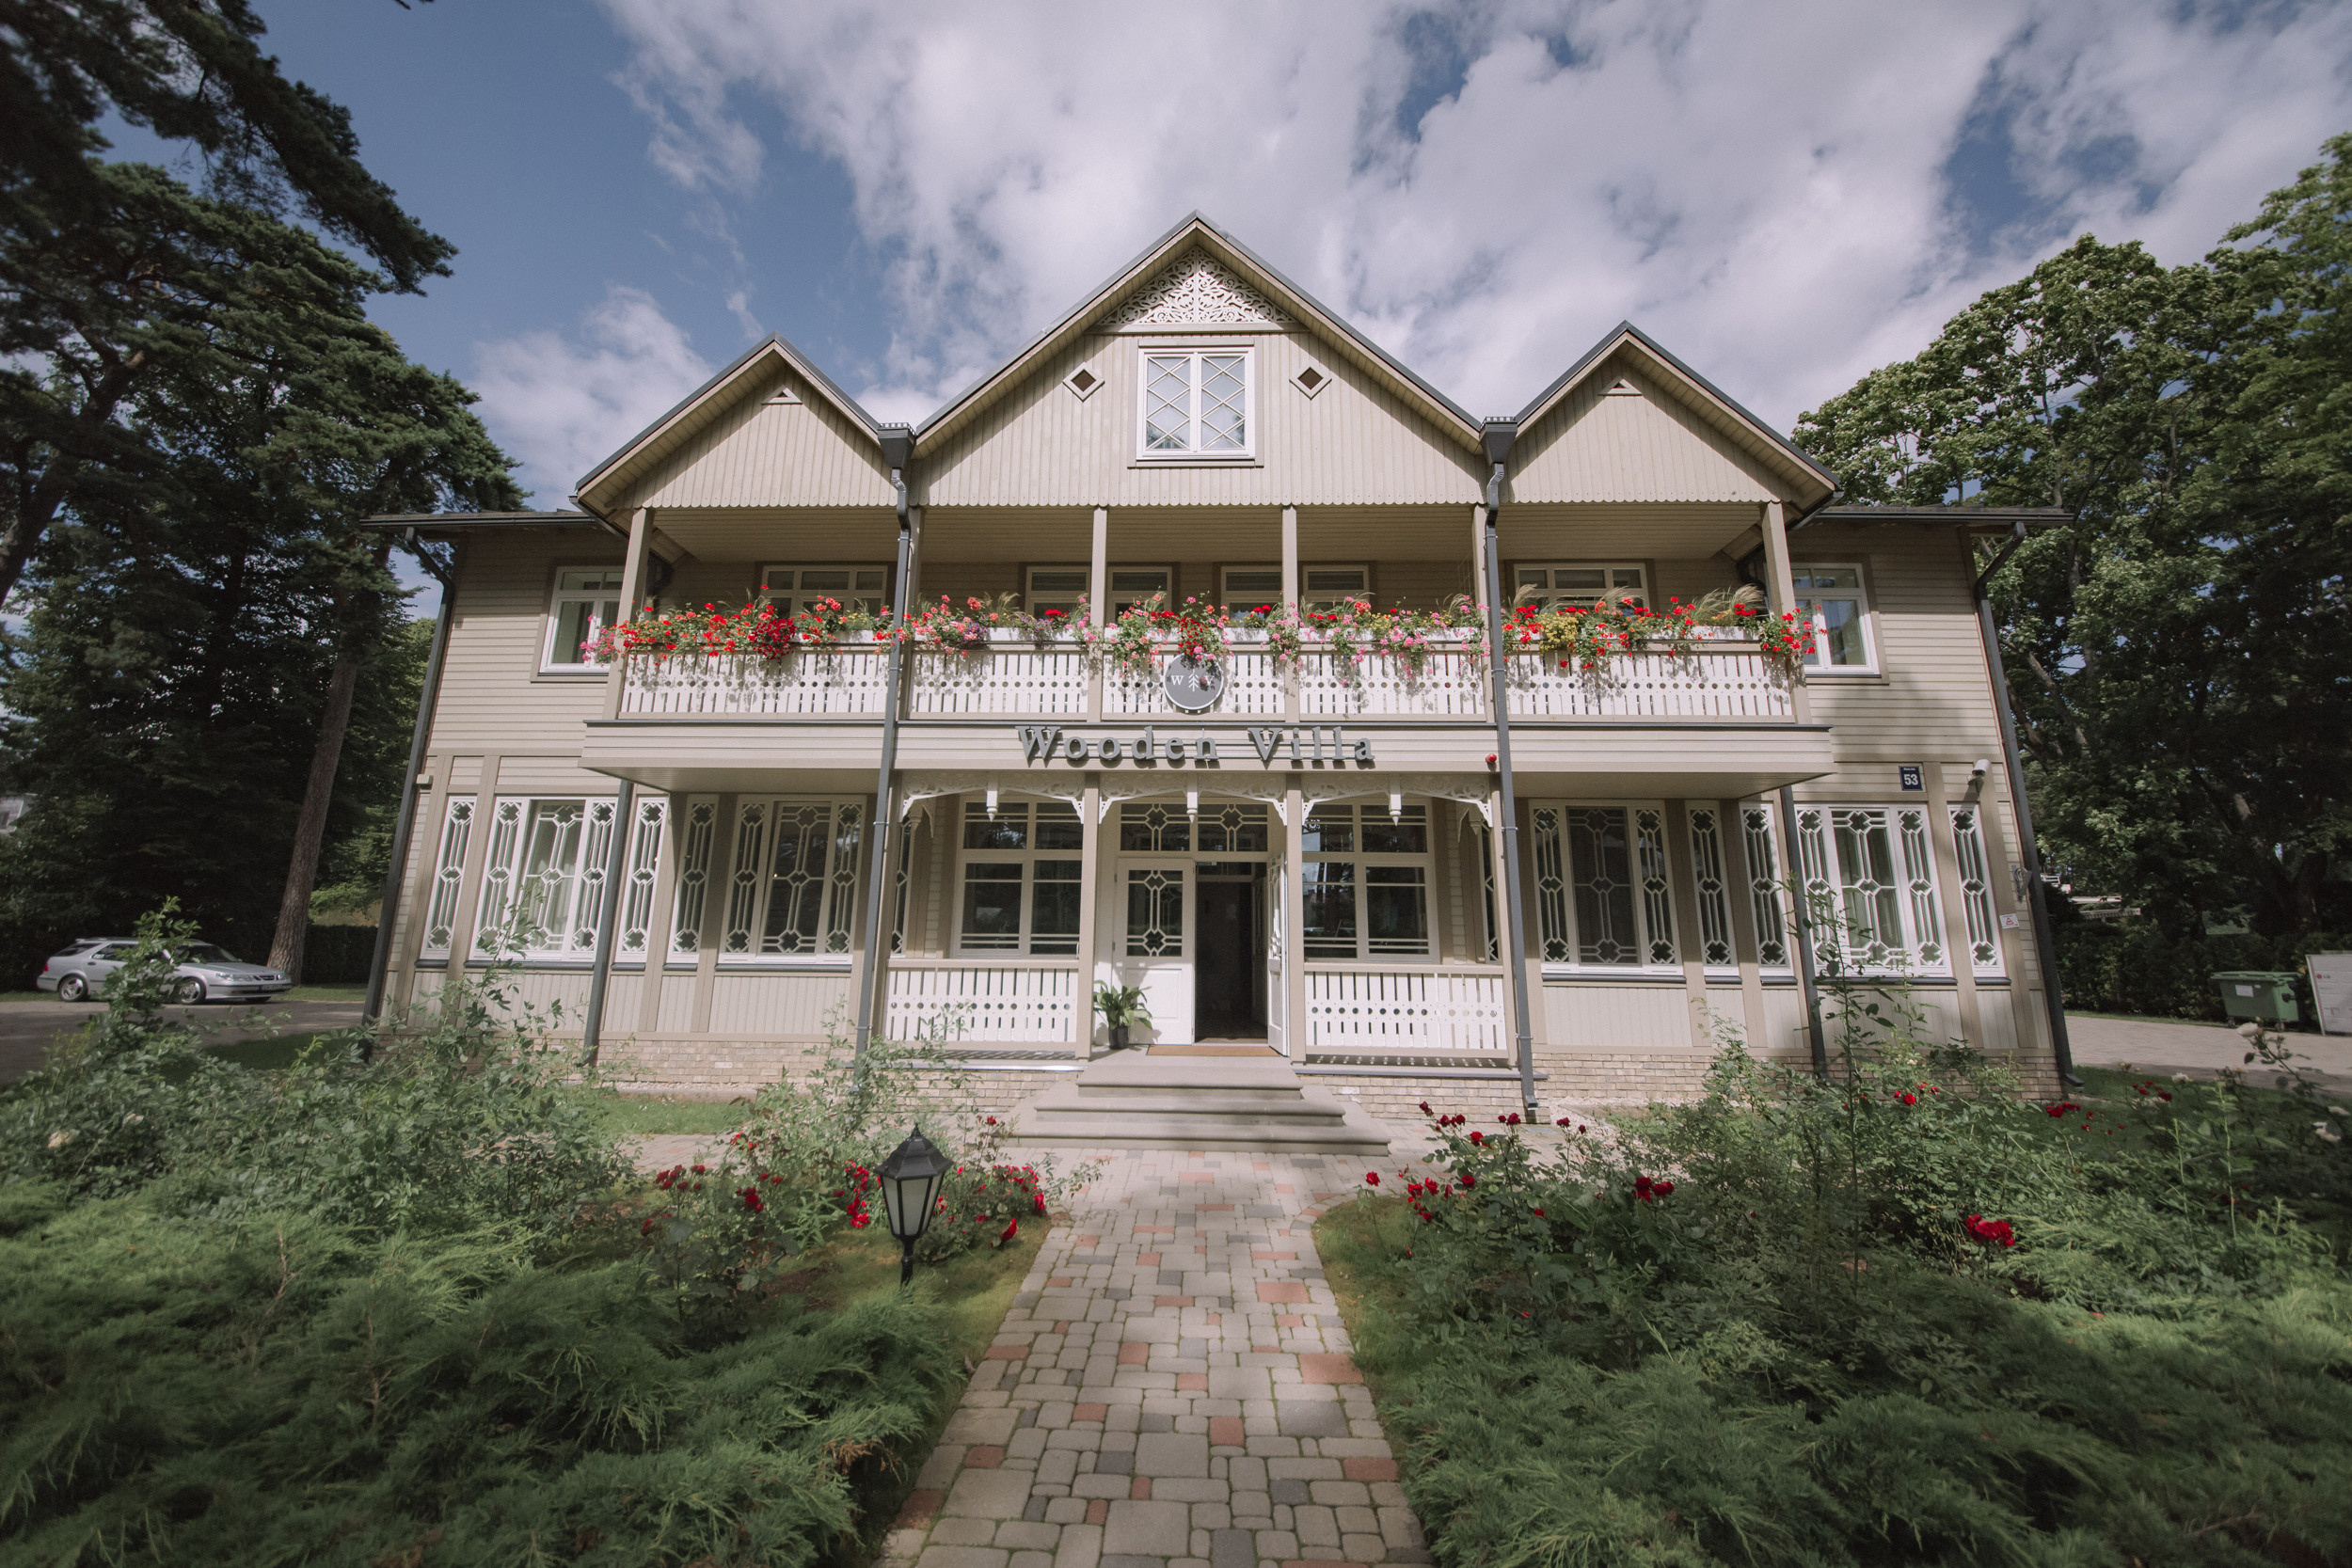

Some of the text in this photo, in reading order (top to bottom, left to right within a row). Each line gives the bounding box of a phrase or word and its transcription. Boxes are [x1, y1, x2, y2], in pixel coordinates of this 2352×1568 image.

[1170, 674, 1184, 686] W
[1016, 725, 1375, 761] Wooden Villa
[1903, 773, 1919, 785] 53
